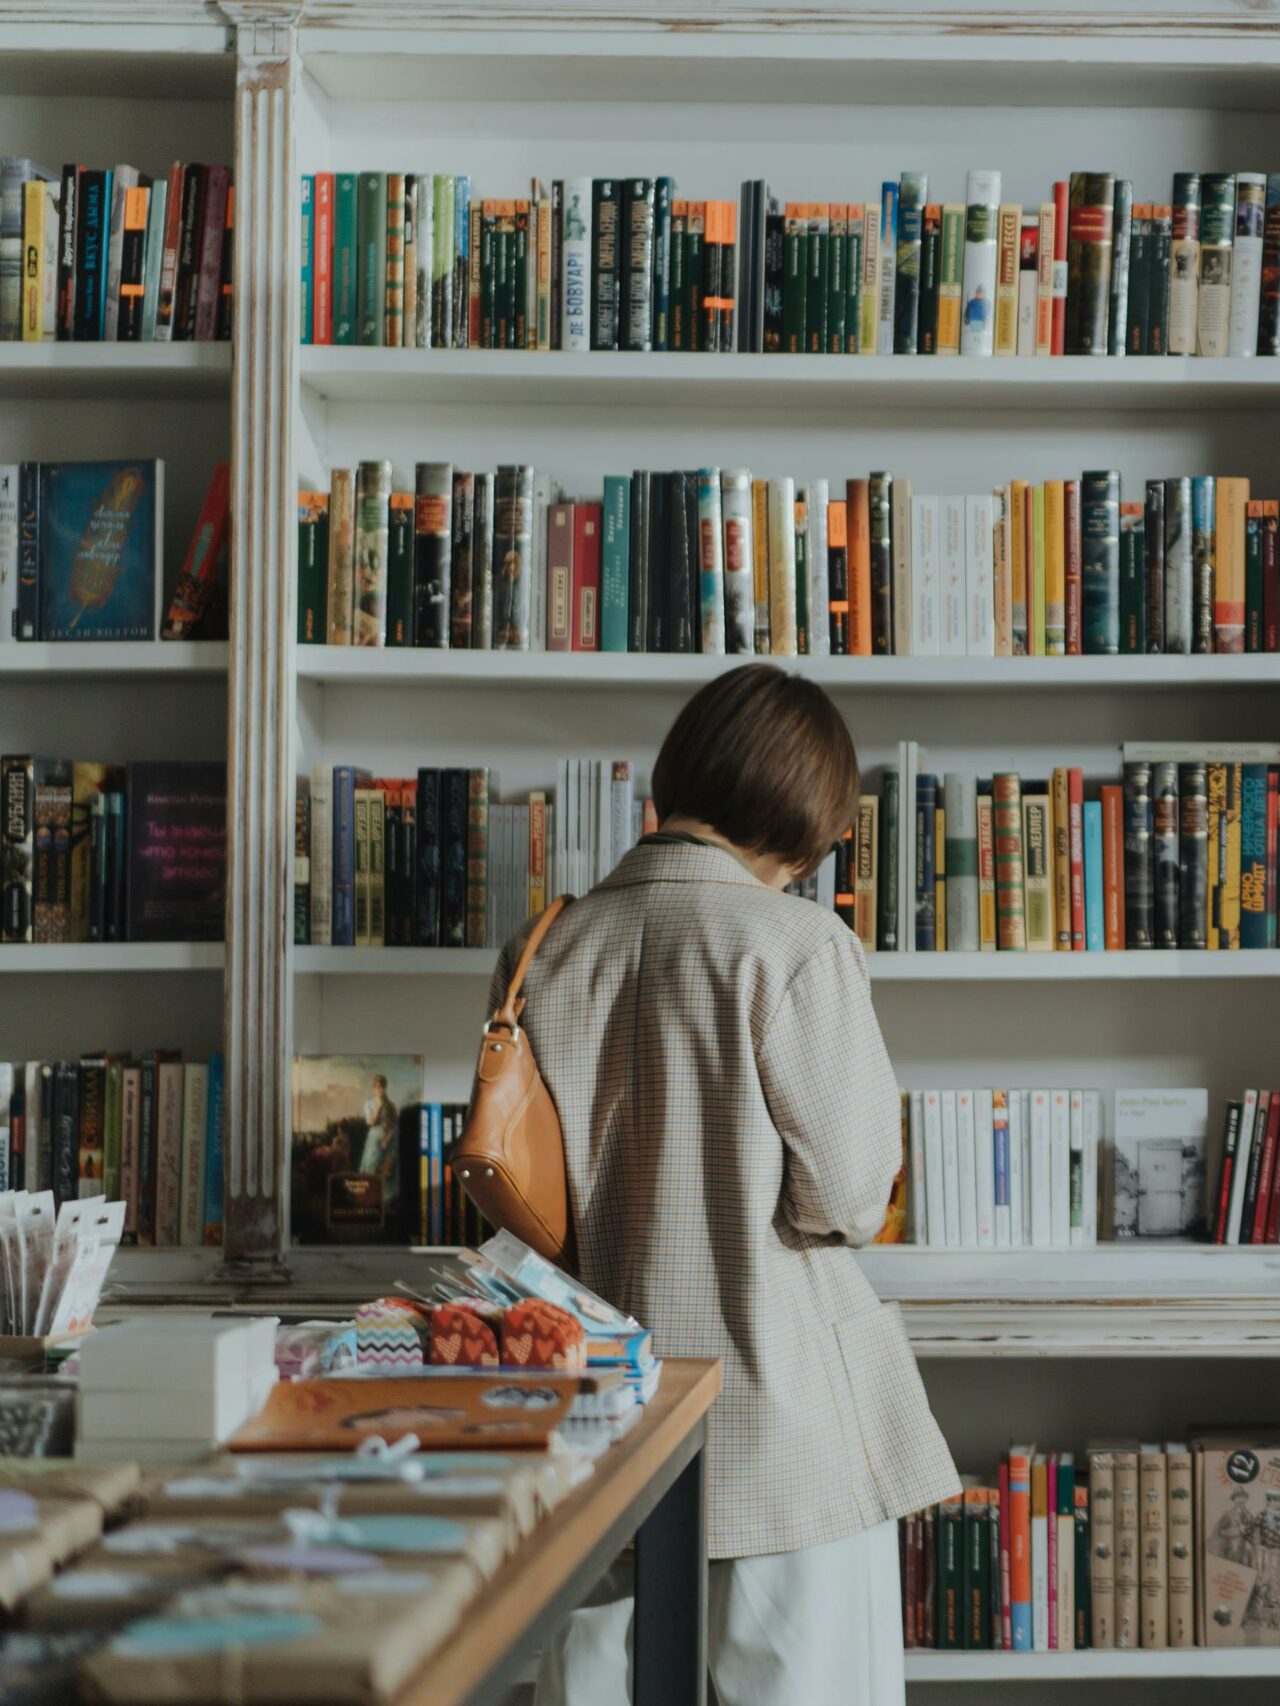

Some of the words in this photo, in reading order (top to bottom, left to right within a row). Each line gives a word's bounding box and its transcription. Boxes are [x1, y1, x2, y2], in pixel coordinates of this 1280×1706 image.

[65, 176, 76, 231] барабанщик
[86, 184, 99, 228] ДЫМА
[599, 201, 617, 233] СЕРДЦА
[62, 231, 73, 267] Другой
[1003, 215, 1015, 249] ГЕССЕ
[84, 231, 98, 270] ВКУС
[599, 234, 615, 268] СМЕРТЬ
[1005, 250, 1014, 283] ГЕРМАН
[570, 321, 583, 336] ДЕ
[8, 771, 25, 837] ДУБЛИН
[1254, 778, 1267, 814] ДЕТИ
[533, 803, 542, 839] РЕМАРК
[861, 807, 872, 845] УАЙЛЬД
[981, 808, 991, 850] ХАКСЛИ
[1030, 806, 1042, 848] ХЕЛЛЕР
[1241, 778, 1254, 856] НИЧЕЙНОГО
[1254, 817, 1266, 856] ОТЦА
[860, 847, 870, 876] ОСКАР
[1242, 872, 1253, 908] АРНО
[1252, 862, 1265, 912] ШМИДТ
[1231, 1453, 1256, 1478] 12
